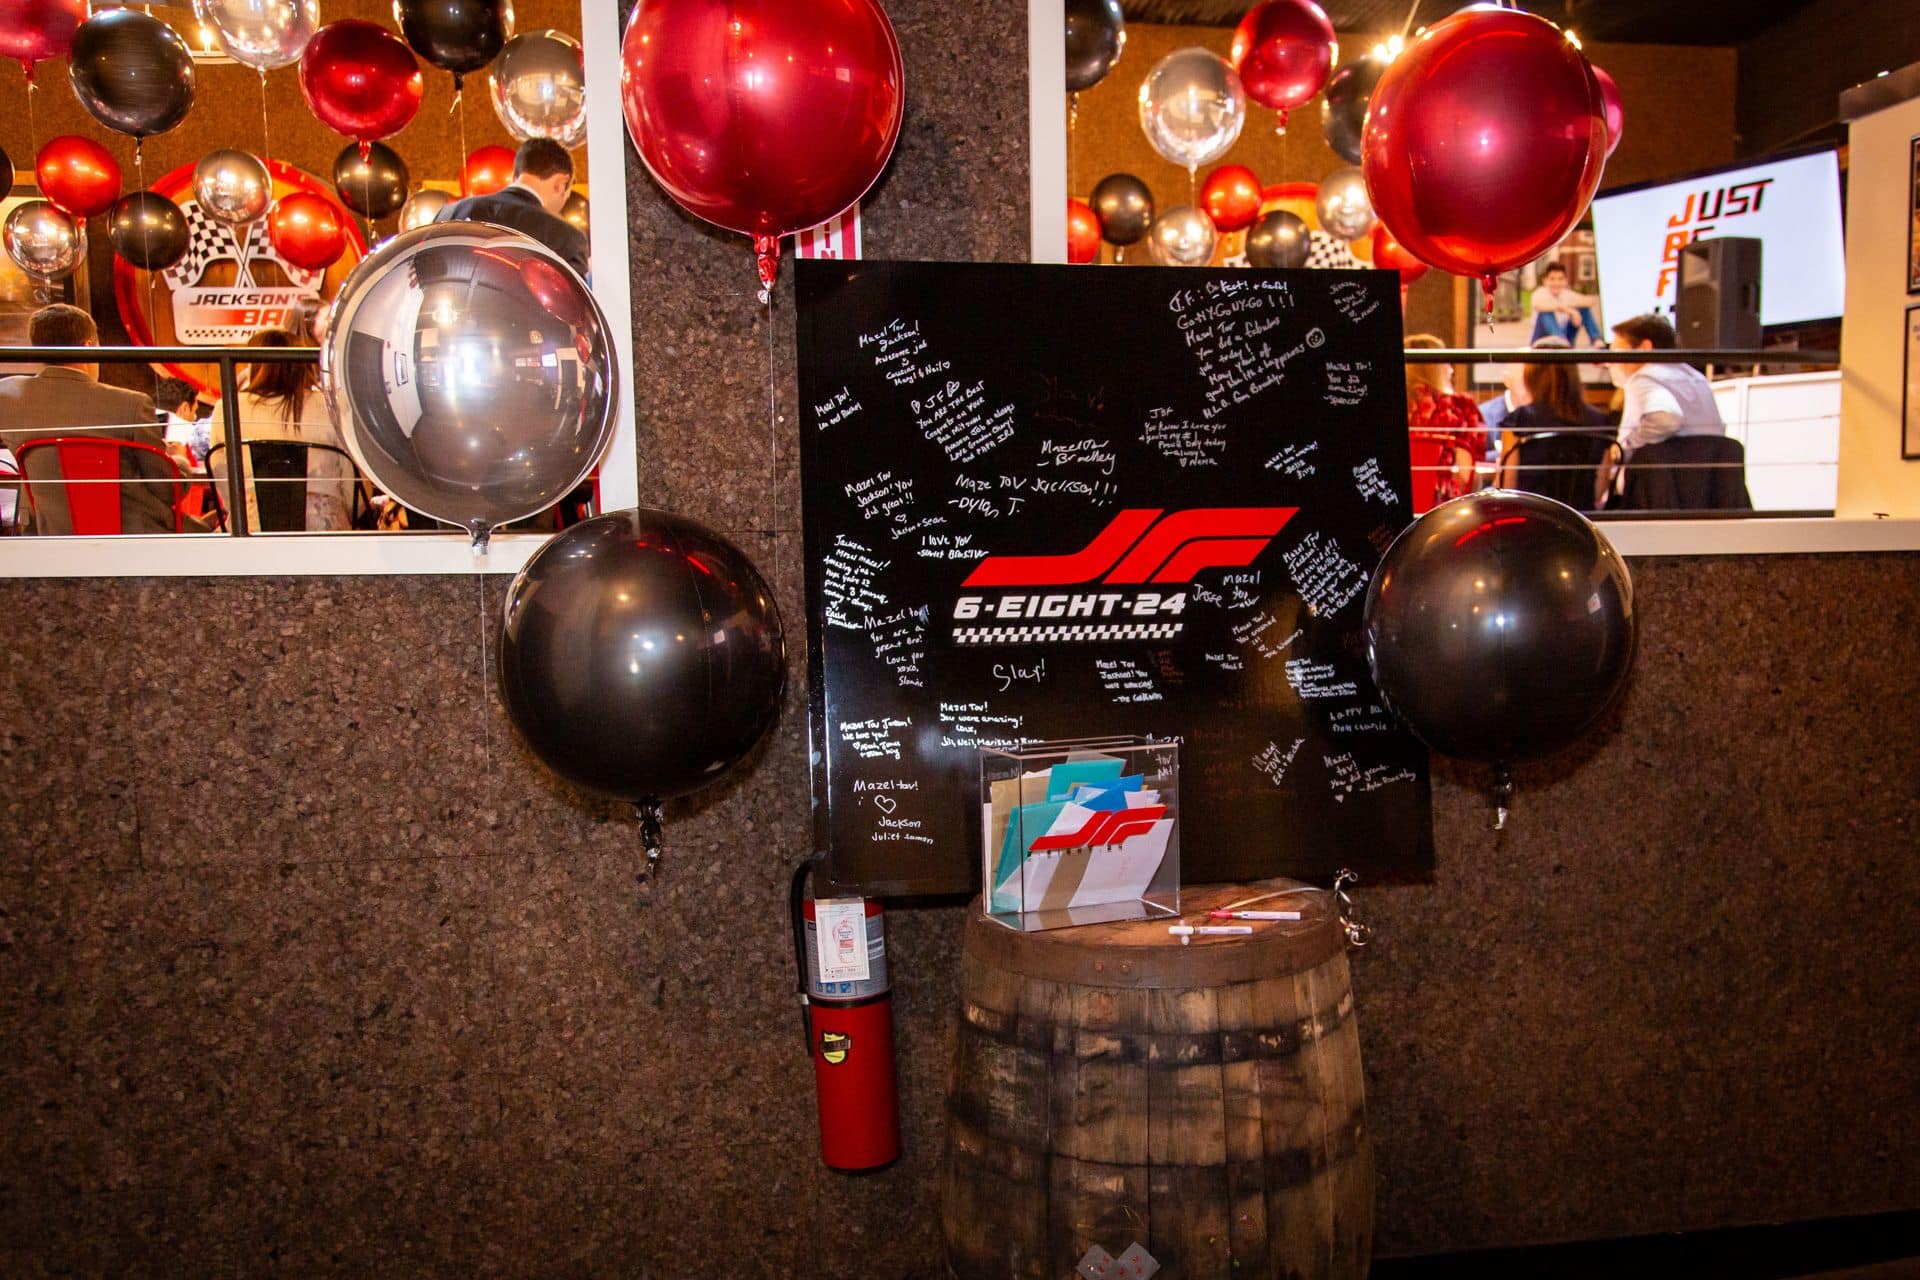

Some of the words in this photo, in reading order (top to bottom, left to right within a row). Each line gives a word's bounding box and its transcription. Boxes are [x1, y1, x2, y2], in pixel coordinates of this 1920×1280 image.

[1668, 178, 1774, 228] JUST
[844, 477, 875, 498] Mazel
[877, 471, 891, 483] Tov
[857, 483, 895, 508] Jackson!
[864, 504, 880, 520] did
[864, 608, 906, 631] Mazel
[878, 815, 921, 829] Jackson
